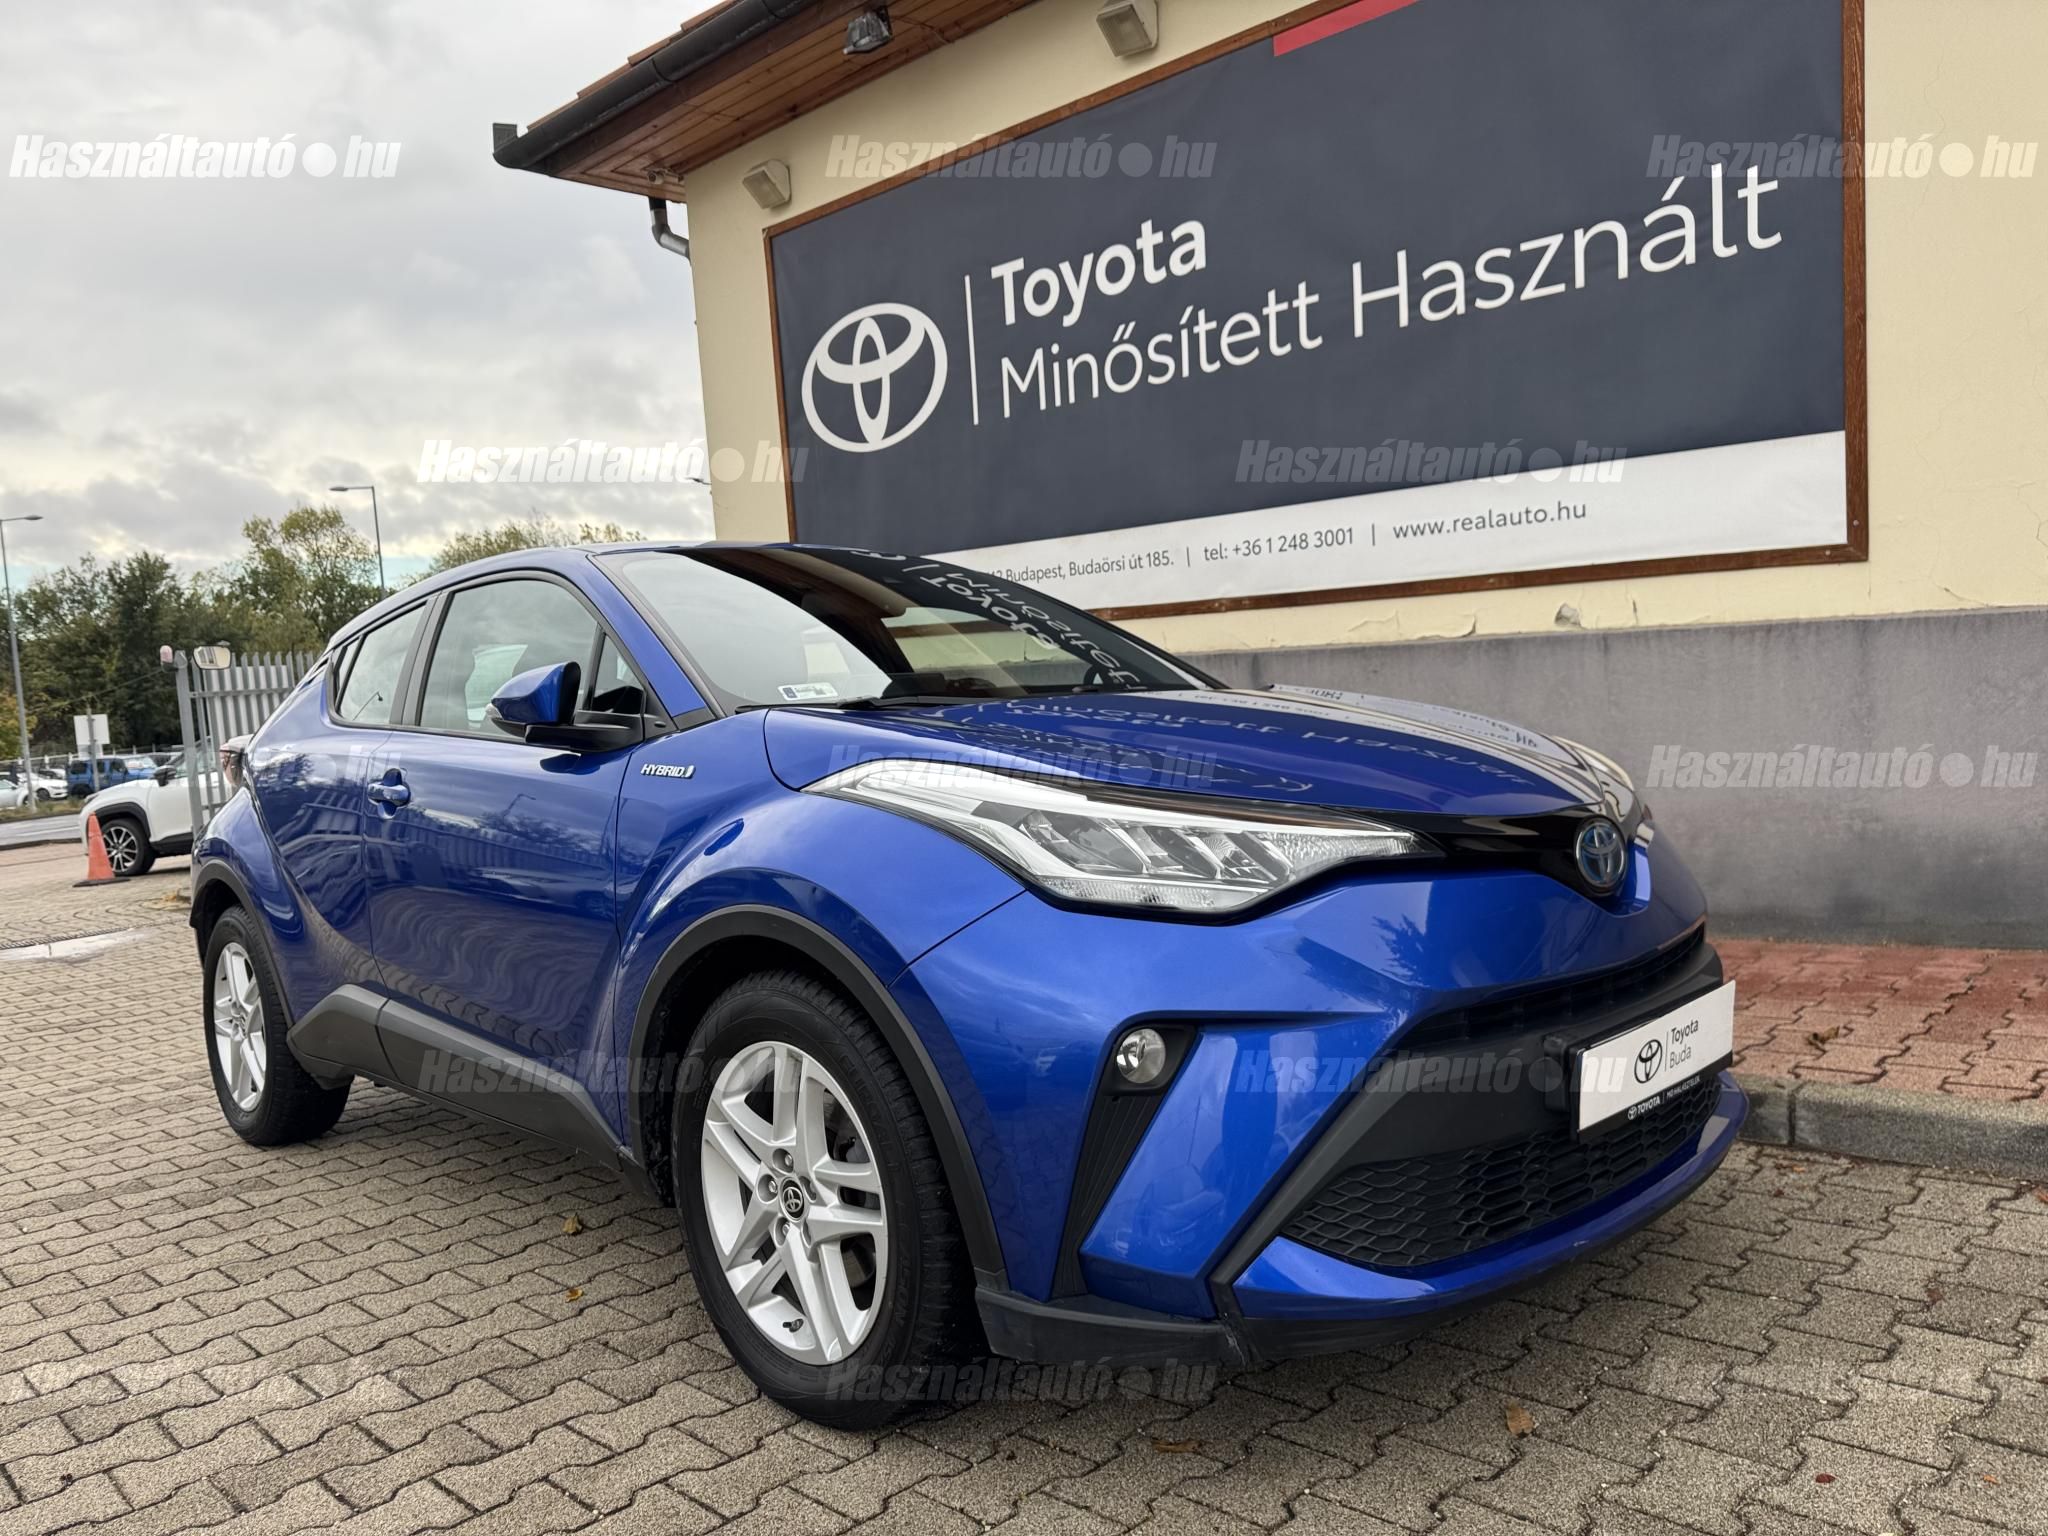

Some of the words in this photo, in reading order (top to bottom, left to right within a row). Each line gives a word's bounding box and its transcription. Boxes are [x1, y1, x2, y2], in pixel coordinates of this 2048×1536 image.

[991, 219, 1206, 328] Toyota
[1001, 280, 1323, 419] Minősített
[1352, 162, 1782, 338] Használt
[1005, 566, 1066, 583] Budapest,
[1069, 555, 1125, 577] Budaörsi
[1129, 553, 1143, 570] út
[1145, 550, 1174, 568] 185.
[1204, 543, 1228, 561] tel:
[1232, 538, 1262, 557] +36
[1278, 532, 1309, 552] 248
[1314, 527, 1353, 549] 3001
[1392, 500, 1587, 539] www.realauto.hu
[640, 763, 685, 778] HYBRID
[1671, 1019, 1699, 1045] Toyota
[1670, 1044, 1692, 1069] Buda
[1637, 1096, 1661, 1114] TOYOTA
